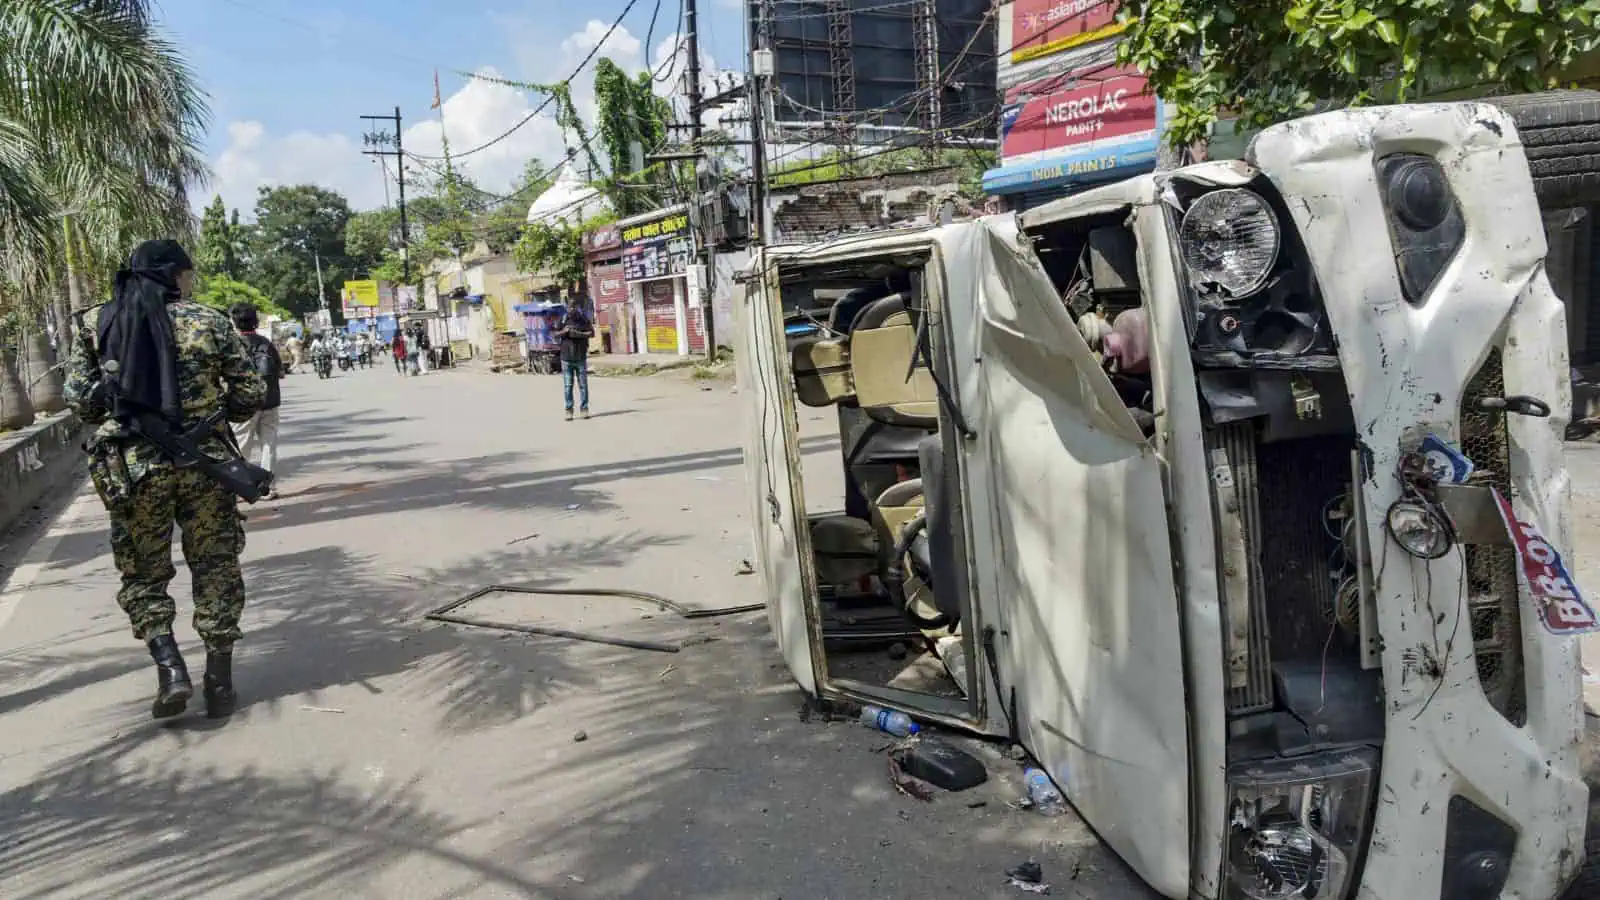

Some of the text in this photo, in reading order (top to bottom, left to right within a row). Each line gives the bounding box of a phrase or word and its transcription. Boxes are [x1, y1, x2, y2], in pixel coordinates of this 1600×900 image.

[1046, 89, 1128, 124] NEROLAC
[1032, 157, 1117, 180] INDIA PAINTS
